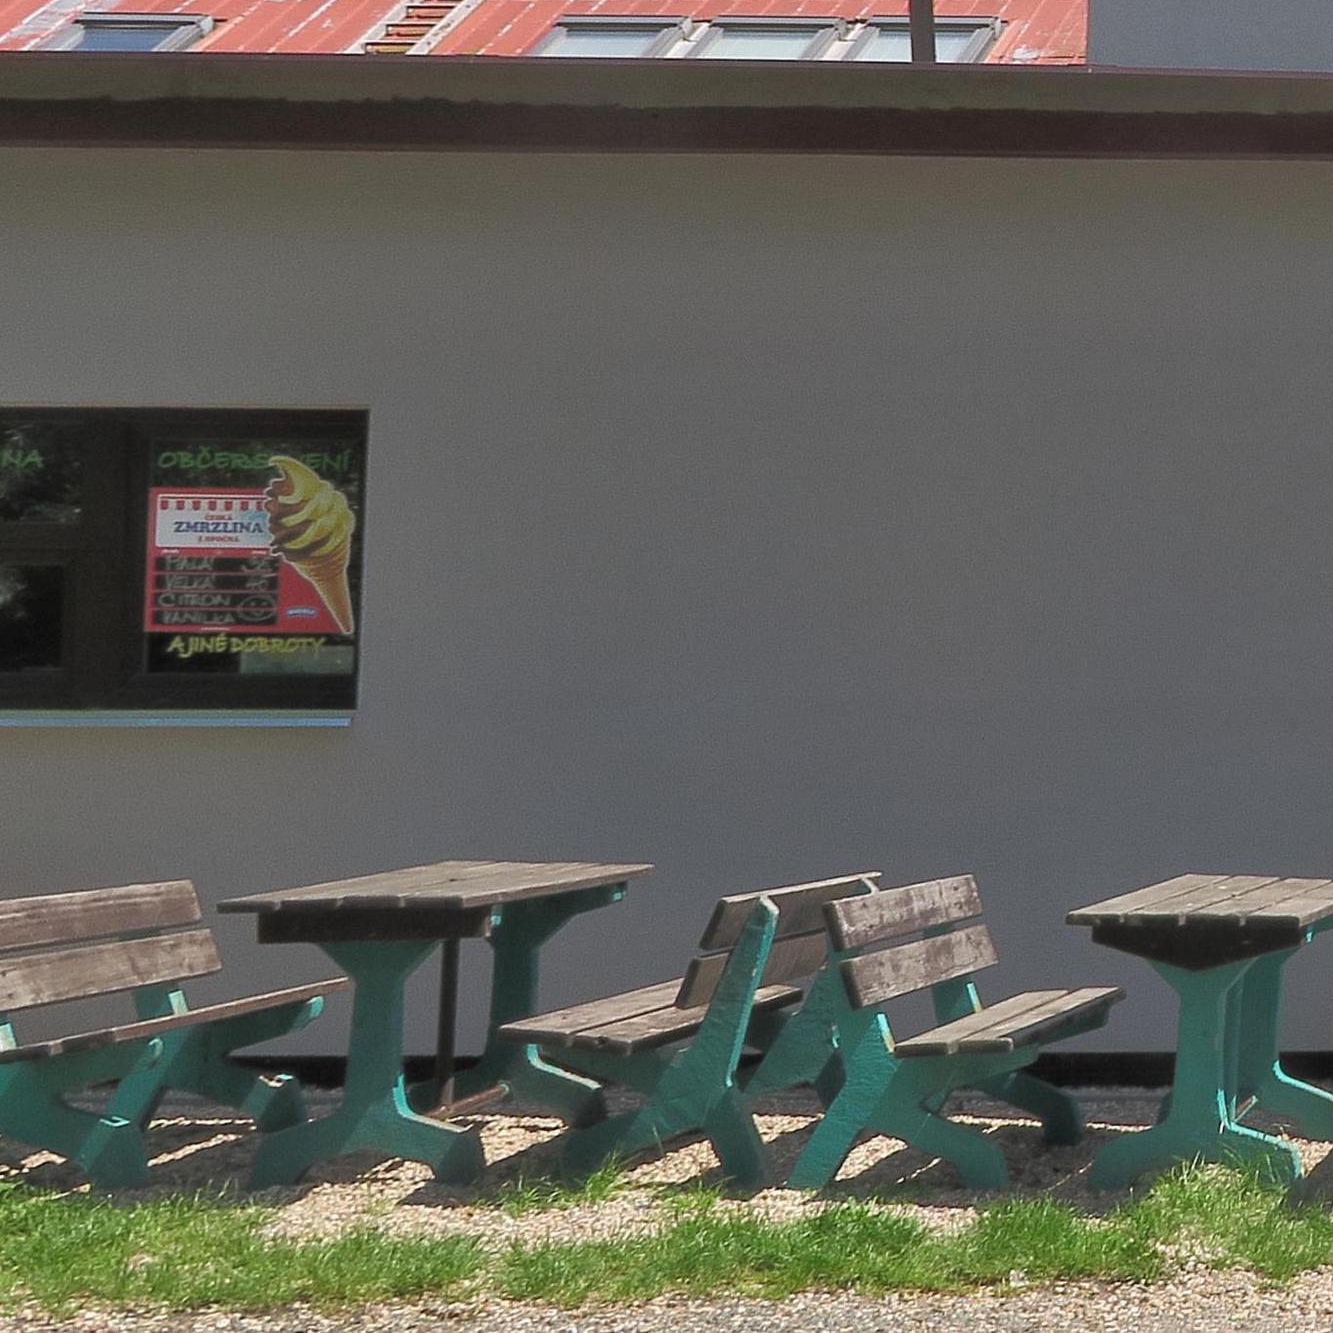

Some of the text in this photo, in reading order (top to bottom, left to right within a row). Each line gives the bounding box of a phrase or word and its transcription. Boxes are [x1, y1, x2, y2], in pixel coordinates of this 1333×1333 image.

[174, 521, 264, 533] ZMRZLINA
[158, 593, 231, 607] CITRON
[231, 636, 327, 658] DOBROTY
